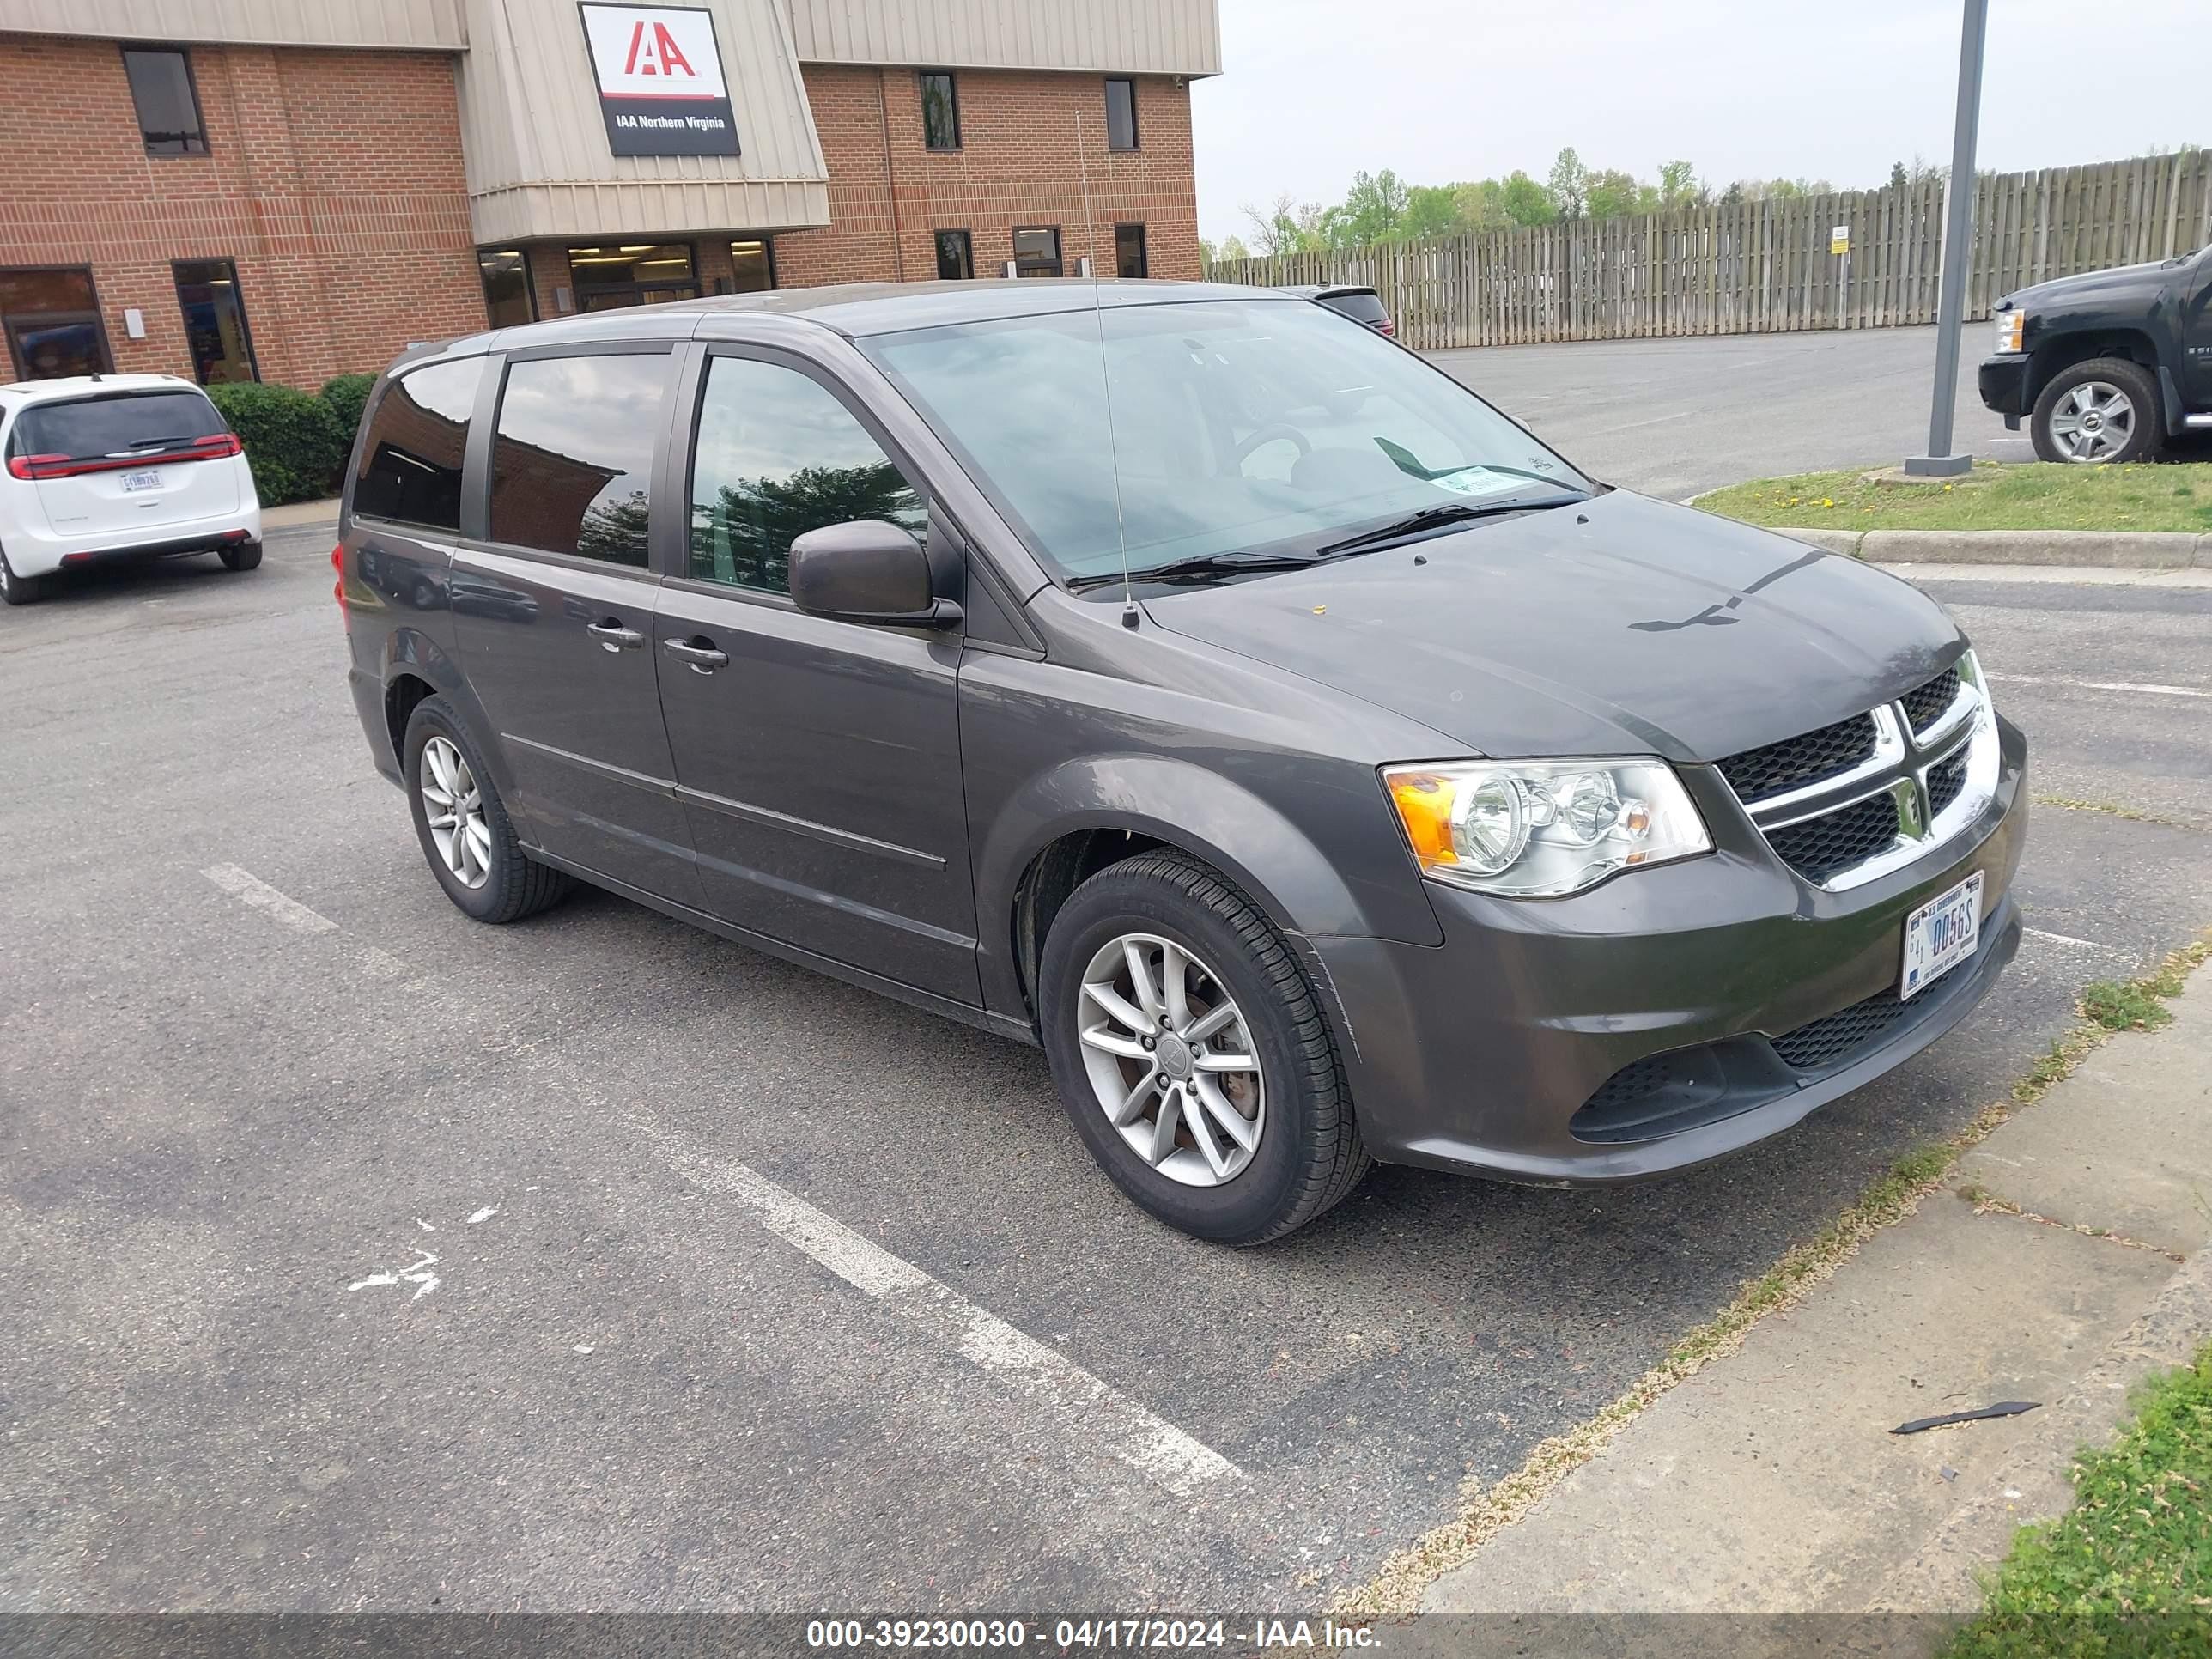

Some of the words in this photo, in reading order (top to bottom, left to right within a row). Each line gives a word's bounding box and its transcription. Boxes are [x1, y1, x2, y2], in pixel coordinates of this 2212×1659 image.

[624, 21, 696, 76] IAA
[616, 115, 638, 128] IAA
[638, 115, 685, 129] Northern
[684, 115, 726, 131] Virginia
[1933, 897, 1973, 957] 0056S
